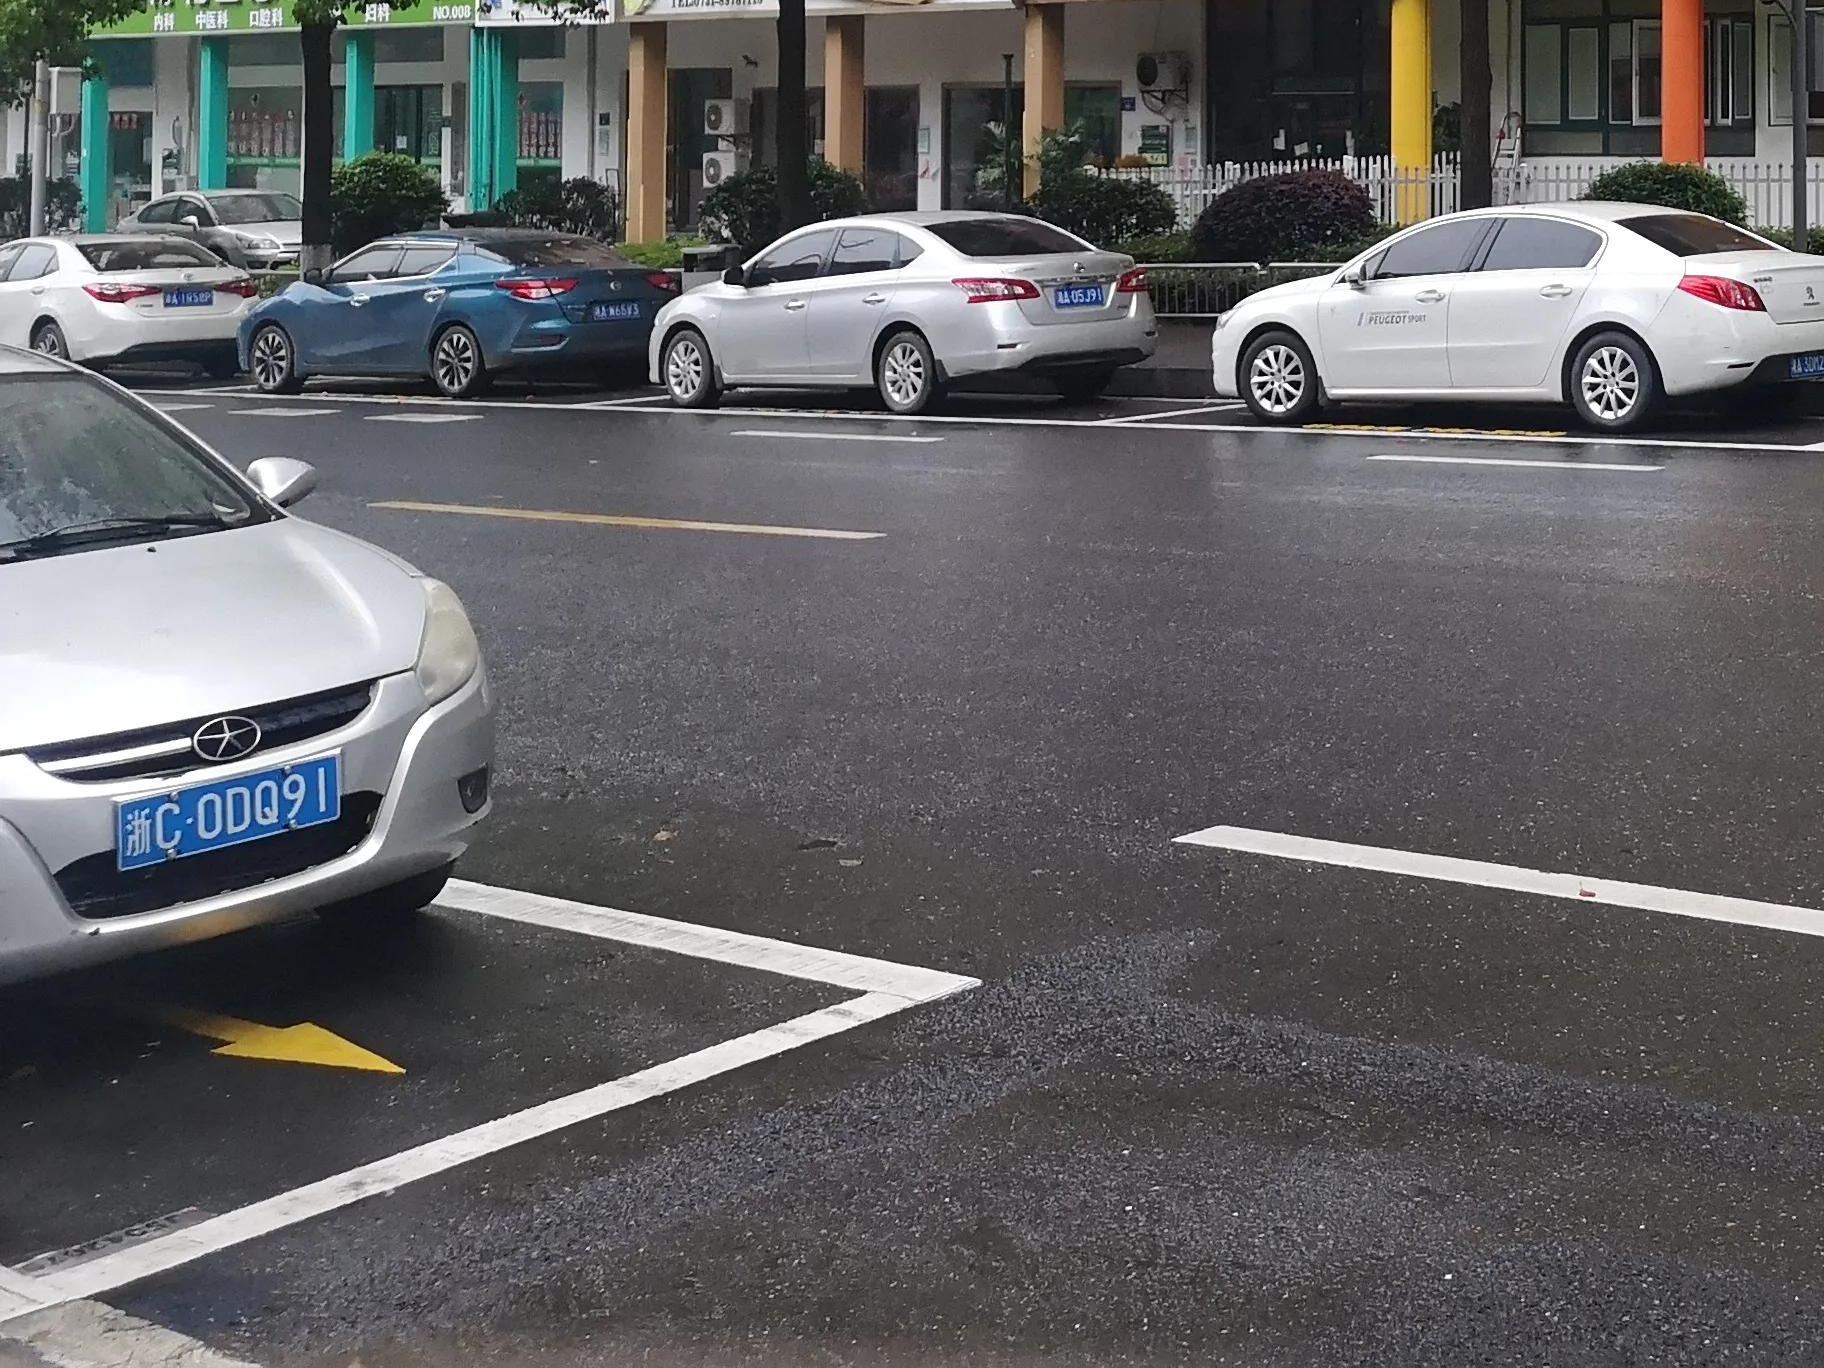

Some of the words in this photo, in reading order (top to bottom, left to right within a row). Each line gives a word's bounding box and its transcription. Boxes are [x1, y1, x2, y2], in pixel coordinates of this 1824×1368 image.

[195, 9, 229, 30] 中医科
[249, 7, 284, 28] 口腔科
[1368, 315, 1407, 325] PEUGEOT
